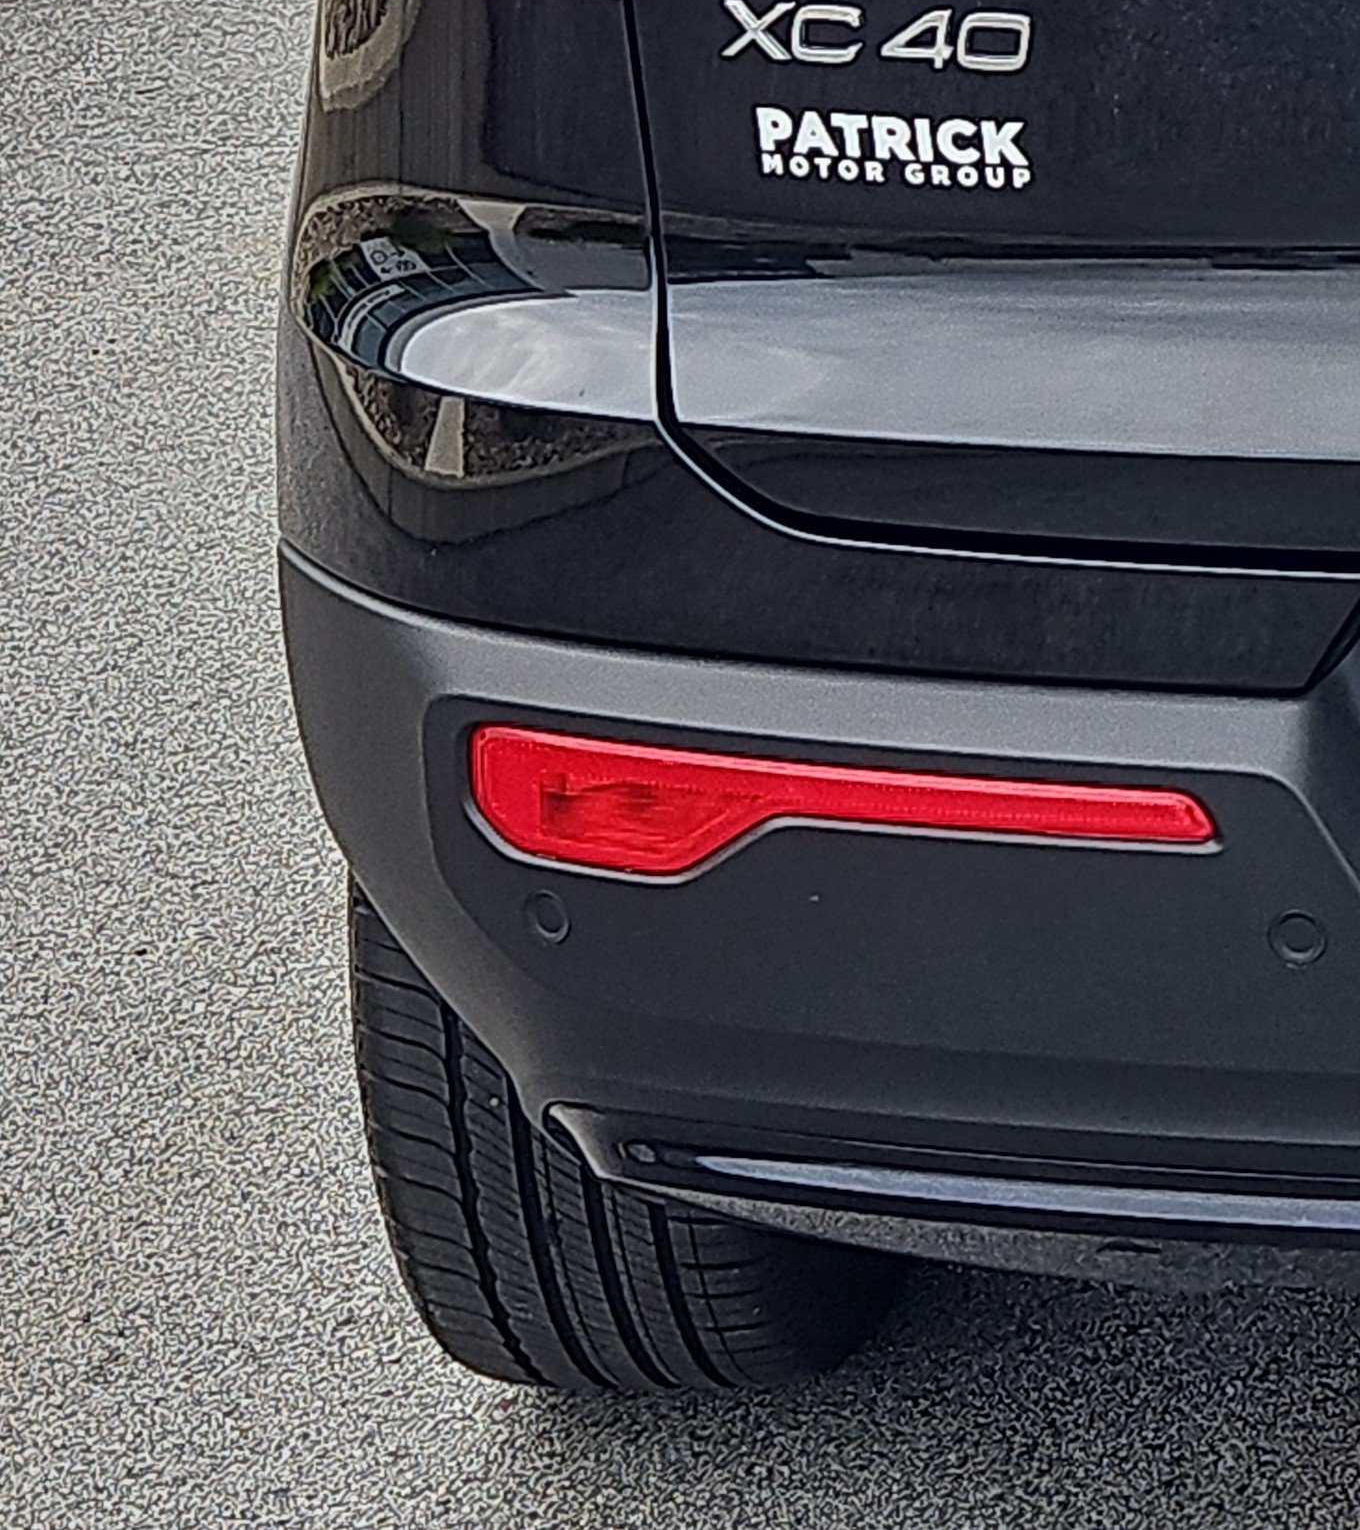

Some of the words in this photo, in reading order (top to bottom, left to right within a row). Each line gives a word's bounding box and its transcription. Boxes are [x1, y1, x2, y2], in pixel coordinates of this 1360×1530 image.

[755, 107, 1029, 166] PATRICK
[762, 154, 886, 183] MOTOR
[904, 164, 1031, 189] GROUP
